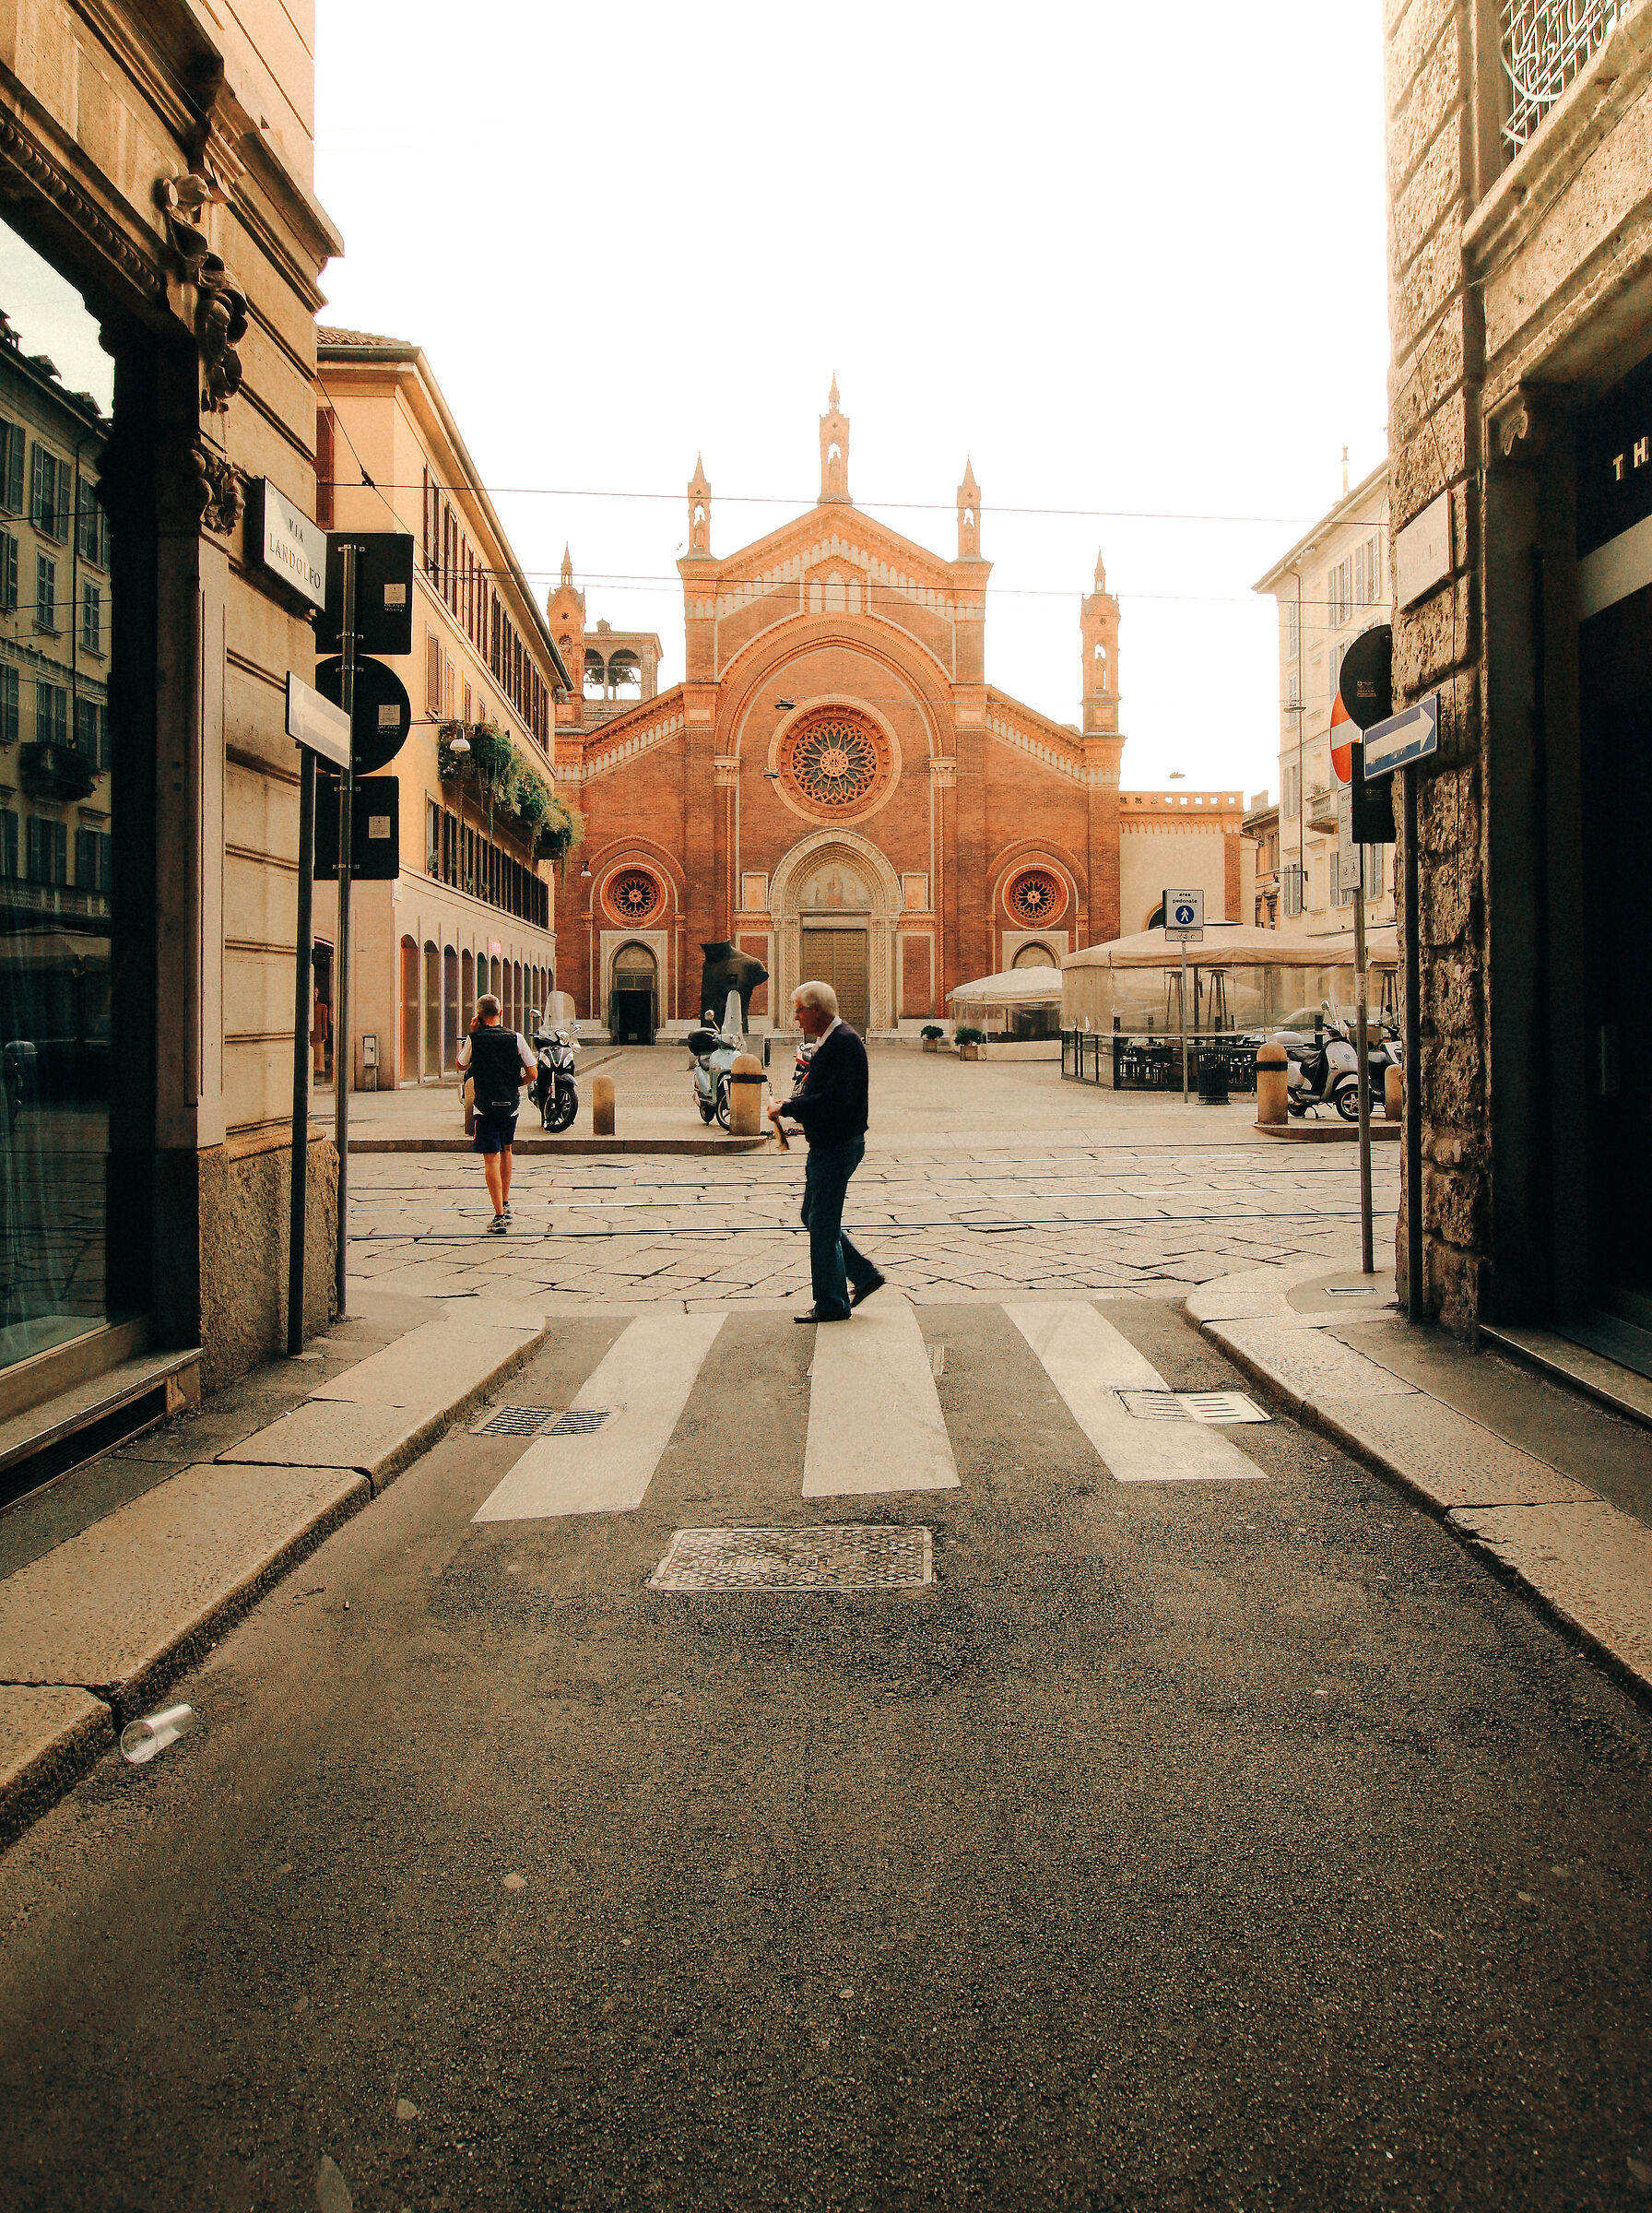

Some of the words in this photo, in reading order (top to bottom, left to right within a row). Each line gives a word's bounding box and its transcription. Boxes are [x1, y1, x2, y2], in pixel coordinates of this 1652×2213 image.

[1612, 436, 1650, 482] TH
[289, 517, 304, 544] VIA
[269, 532, 321, 590] LANDOLFO
